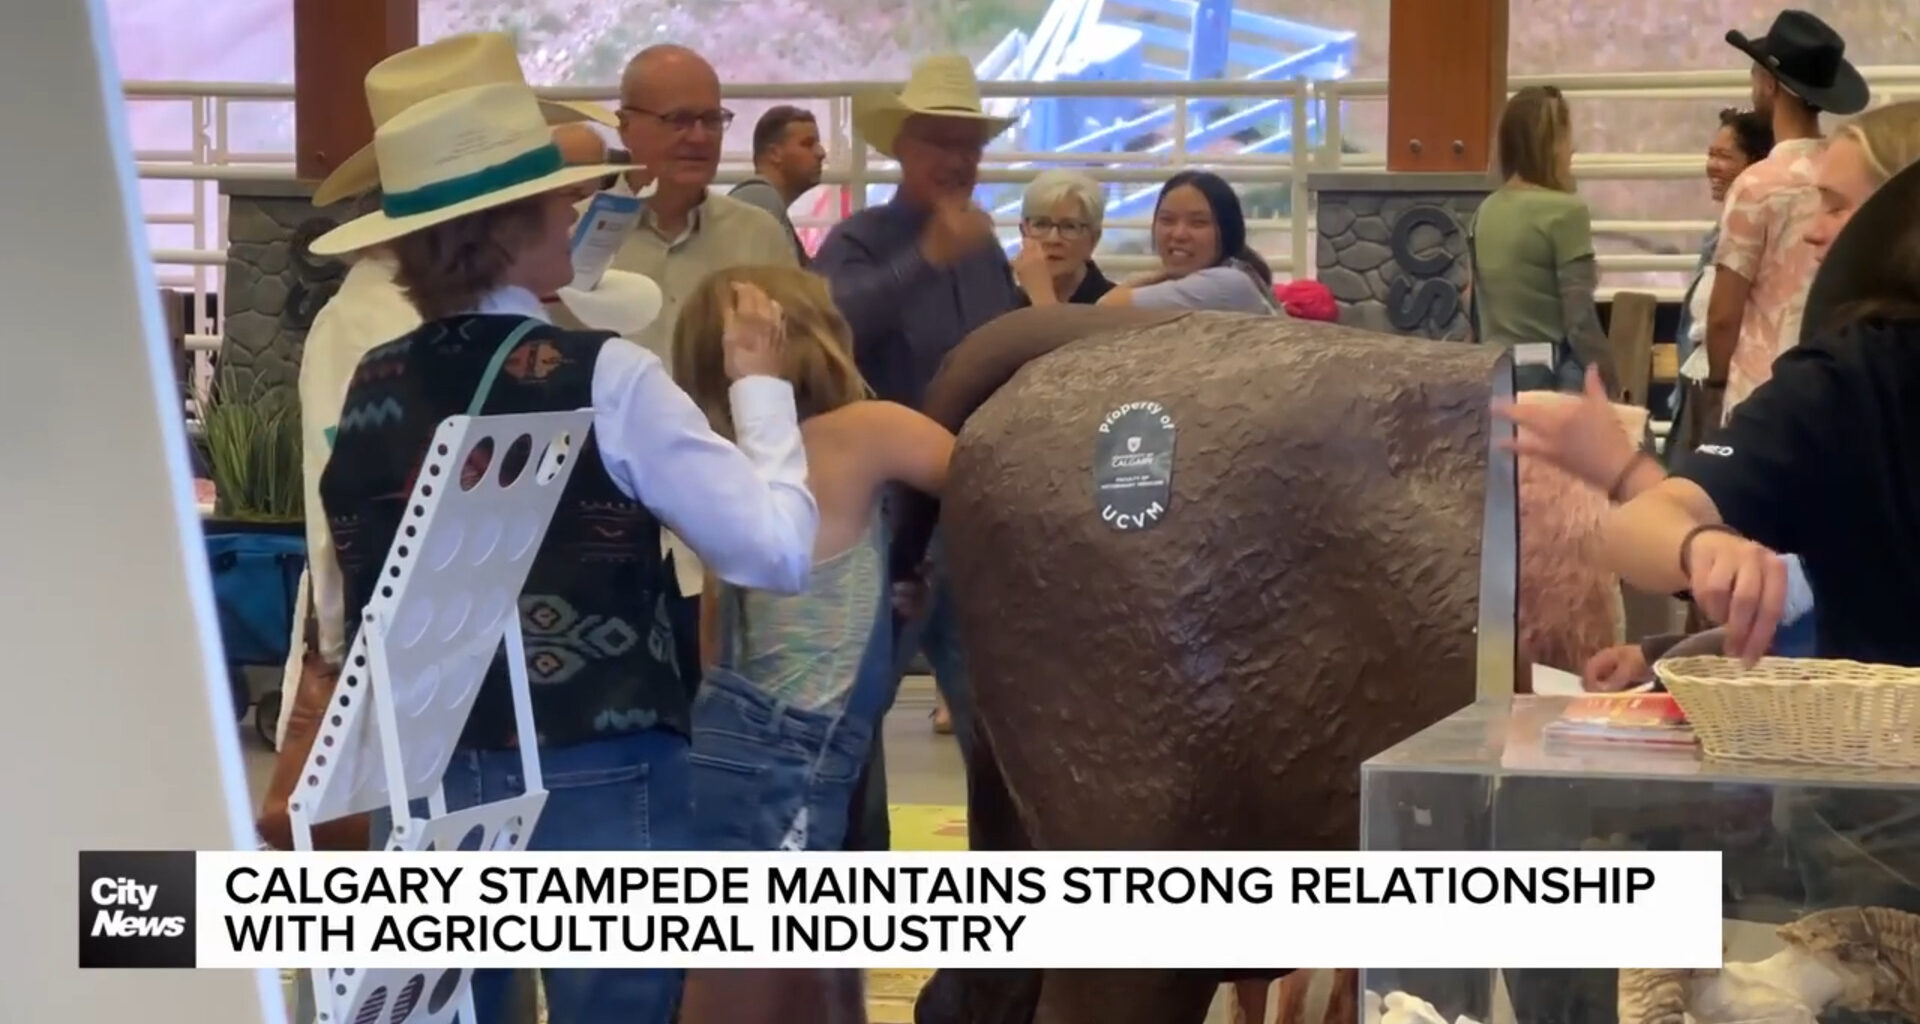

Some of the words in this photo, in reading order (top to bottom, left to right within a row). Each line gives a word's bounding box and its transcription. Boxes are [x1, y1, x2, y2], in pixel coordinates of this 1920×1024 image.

[1099, 402, 1162, 433] Property
[1160, 415, 1176, 430] of
[1102, 500, 1164, 530] UCVM
